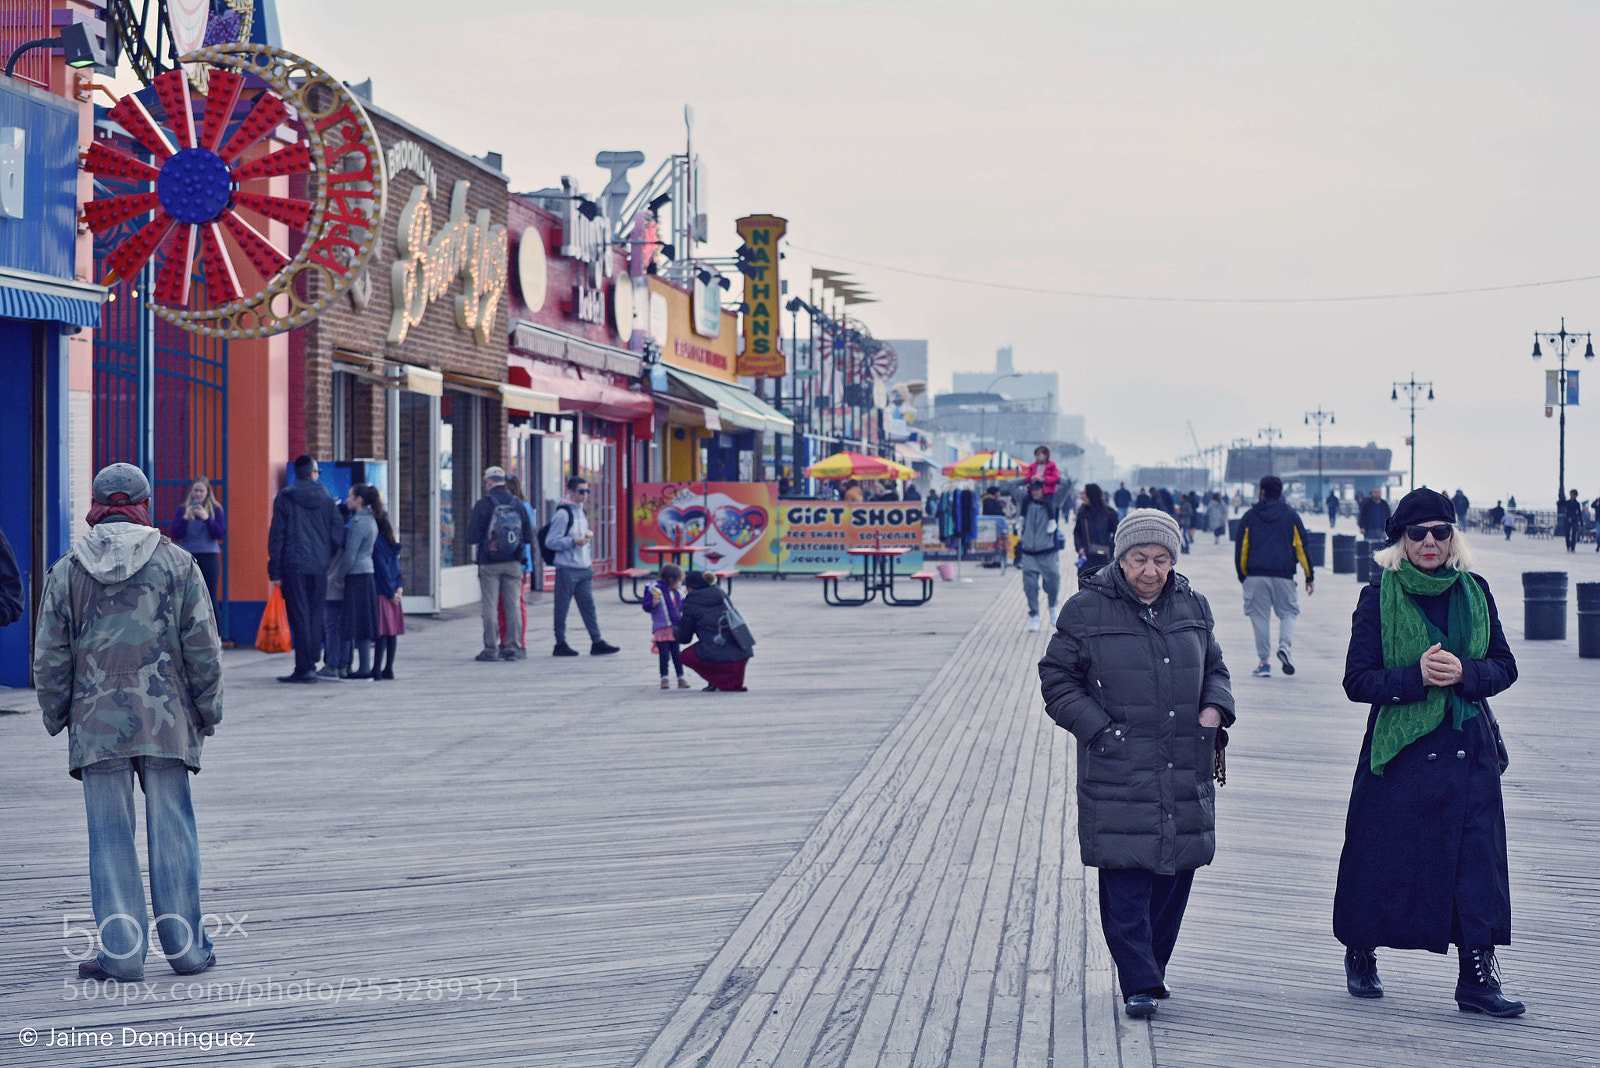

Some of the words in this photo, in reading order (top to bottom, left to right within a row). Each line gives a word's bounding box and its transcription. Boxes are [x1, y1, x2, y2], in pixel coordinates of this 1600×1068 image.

[387, 140, 437, 200] BROOKLYN
[752, 229, 770, 354] NATHANS
[851, 508, 922, 526] SHOP
[786, 543, 846, 551] POSTCARDS
